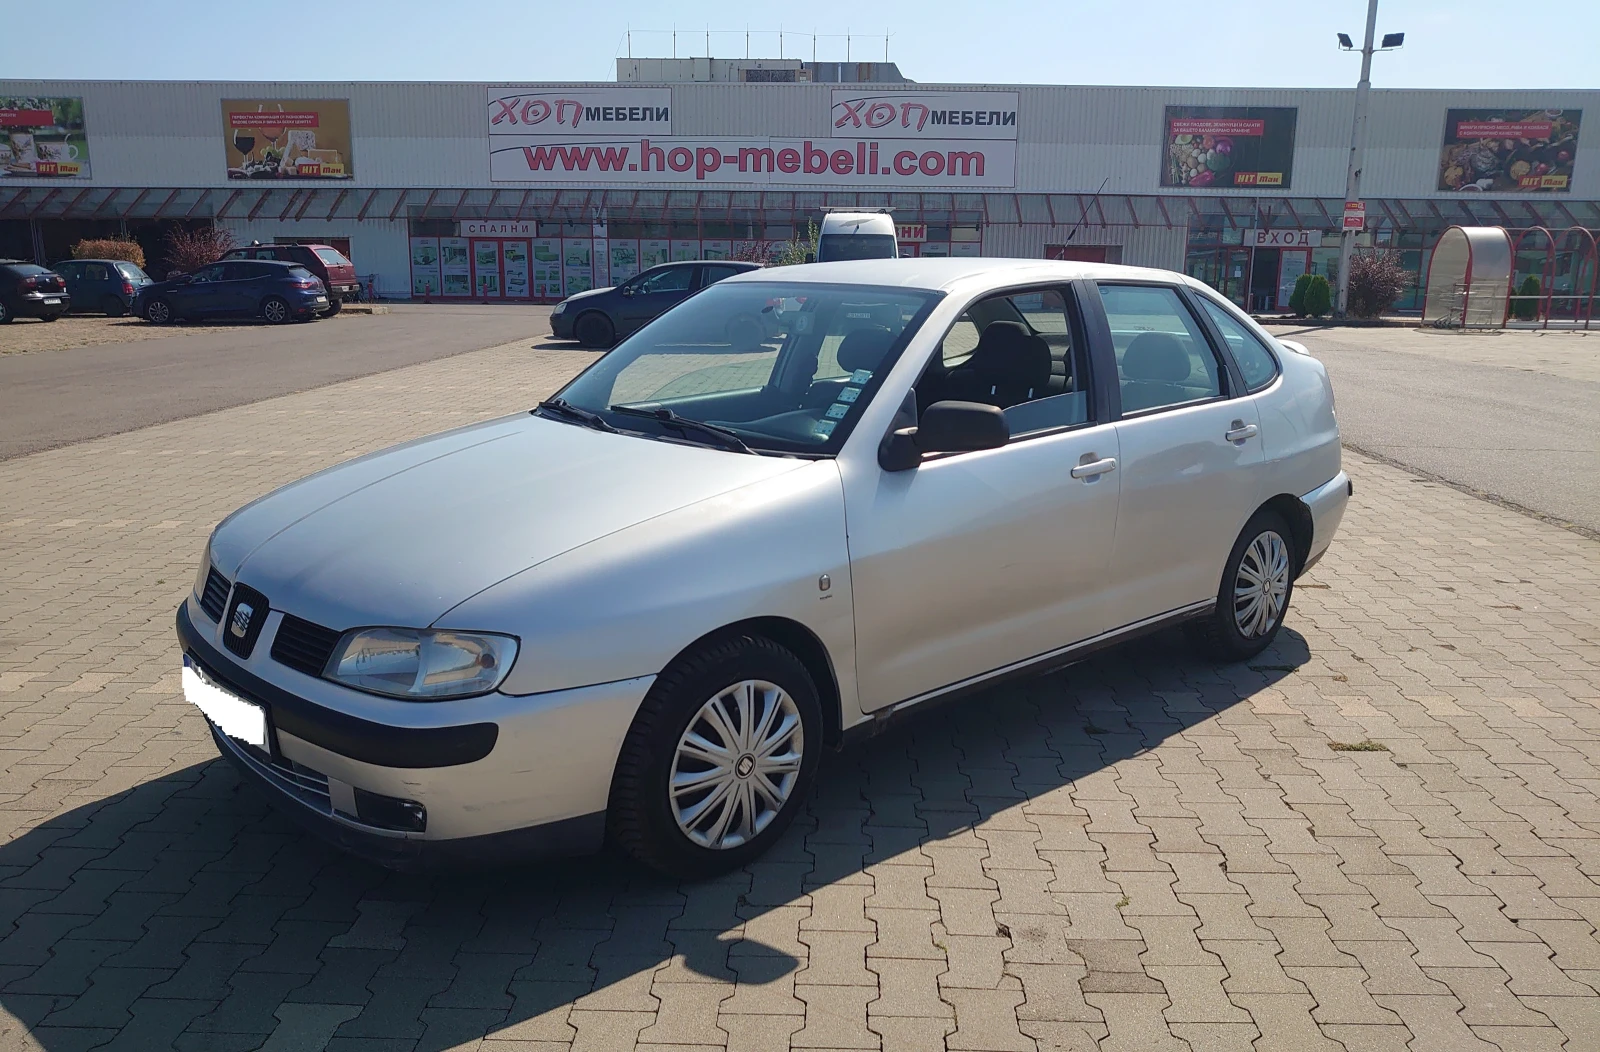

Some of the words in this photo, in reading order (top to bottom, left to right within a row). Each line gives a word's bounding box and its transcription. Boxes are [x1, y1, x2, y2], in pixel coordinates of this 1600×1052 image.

[491, 98, 583, 128] ХОП
[585, 106, 669, 122] МЕБЕЛИ
[835, 99, 930, 132] ХОП
[931, 110, 1016, 126] МЕБЕЛИ
[522, 138, 986, 180] www.hop-mebeli.com
[39, 164, 56, 172] HIT
[302, 165, 319, 174] HIT
[1237, 174, 1256, 183] HIT
[1521, 177, 1540, 186] HIT
[468, 224, 529, 233] СПАЛНИ
[1256, 231, 1309, 246] ВХОД
